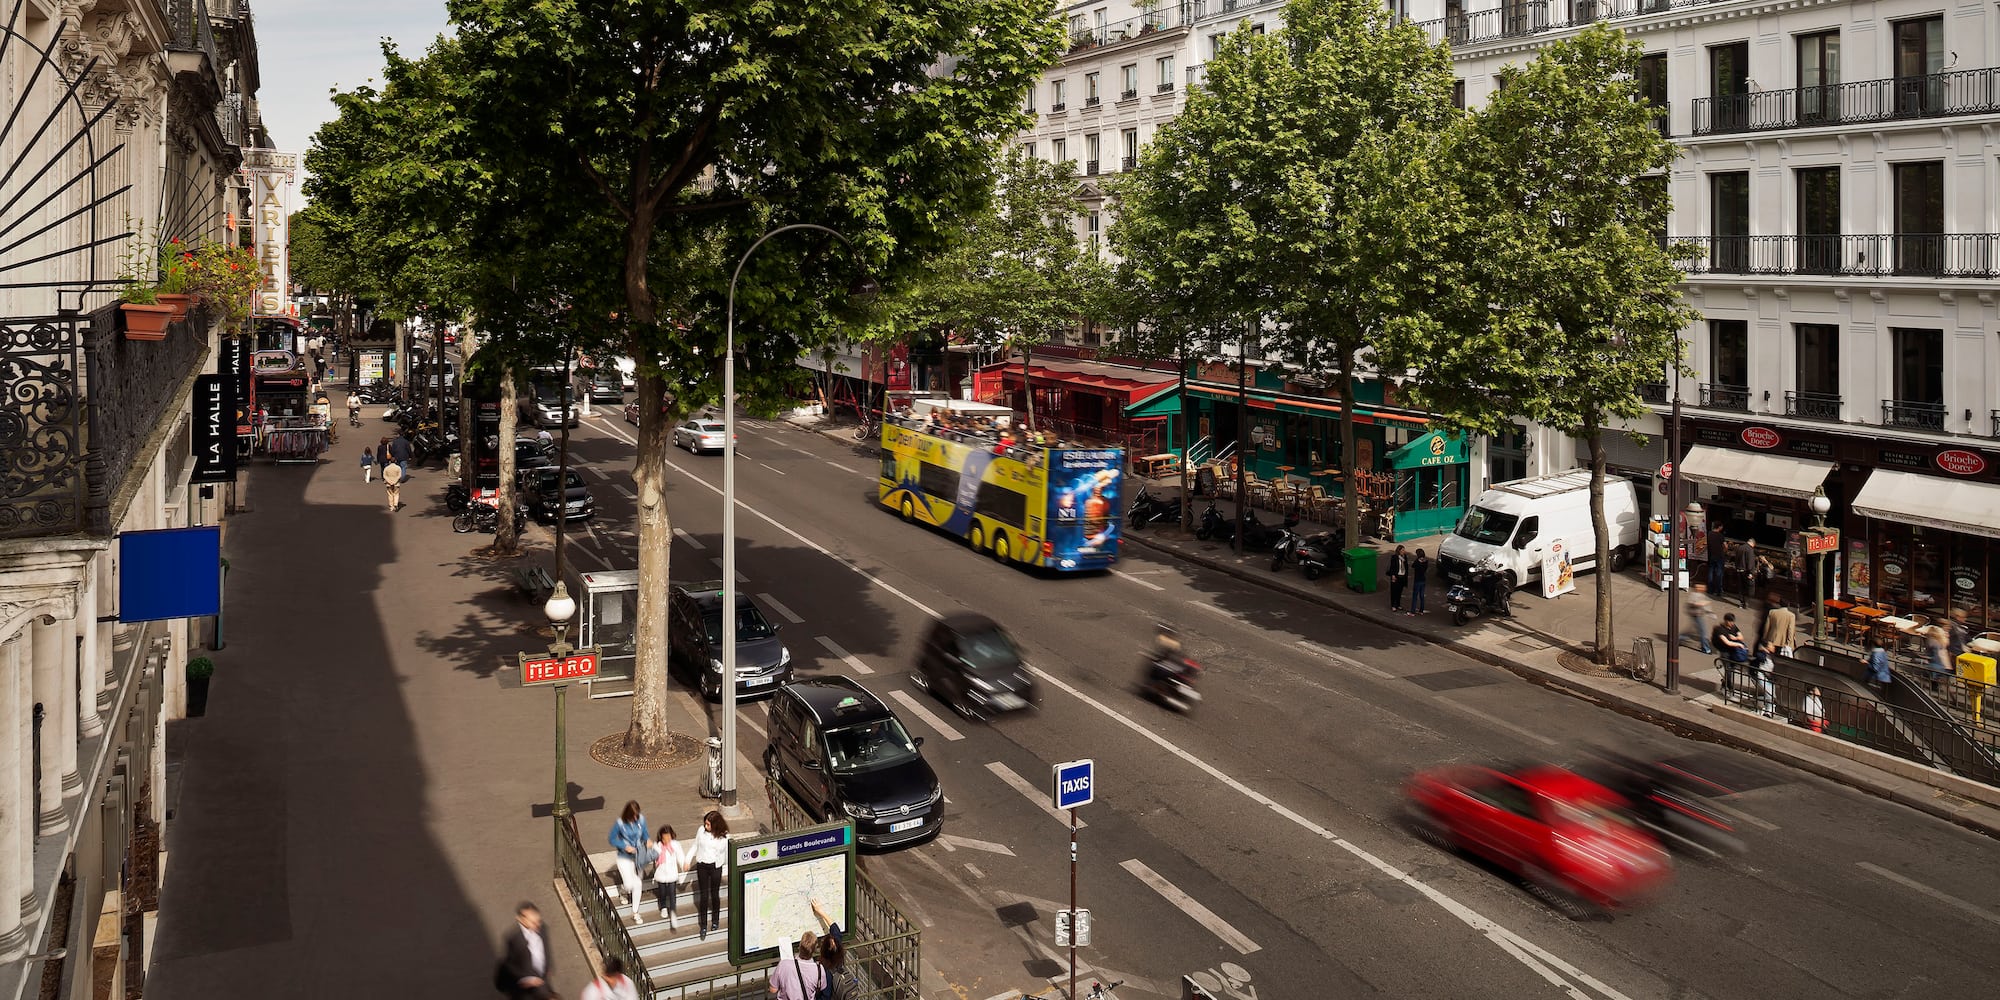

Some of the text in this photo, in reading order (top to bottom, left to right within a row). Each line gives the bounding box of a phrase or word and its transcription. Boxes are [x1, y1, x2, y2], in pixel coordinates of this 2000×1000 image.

[209, 382, 221, 436] HALLE
[209, 442, 220, 464] LA
[1421, 455, 1455, 465] CAFE OZ
[1943, 452, 1978, 466] Brioche
[1062, 775, 1090, 794] TAXIS
[781, 836, 836, 852] Grands Boulevards
